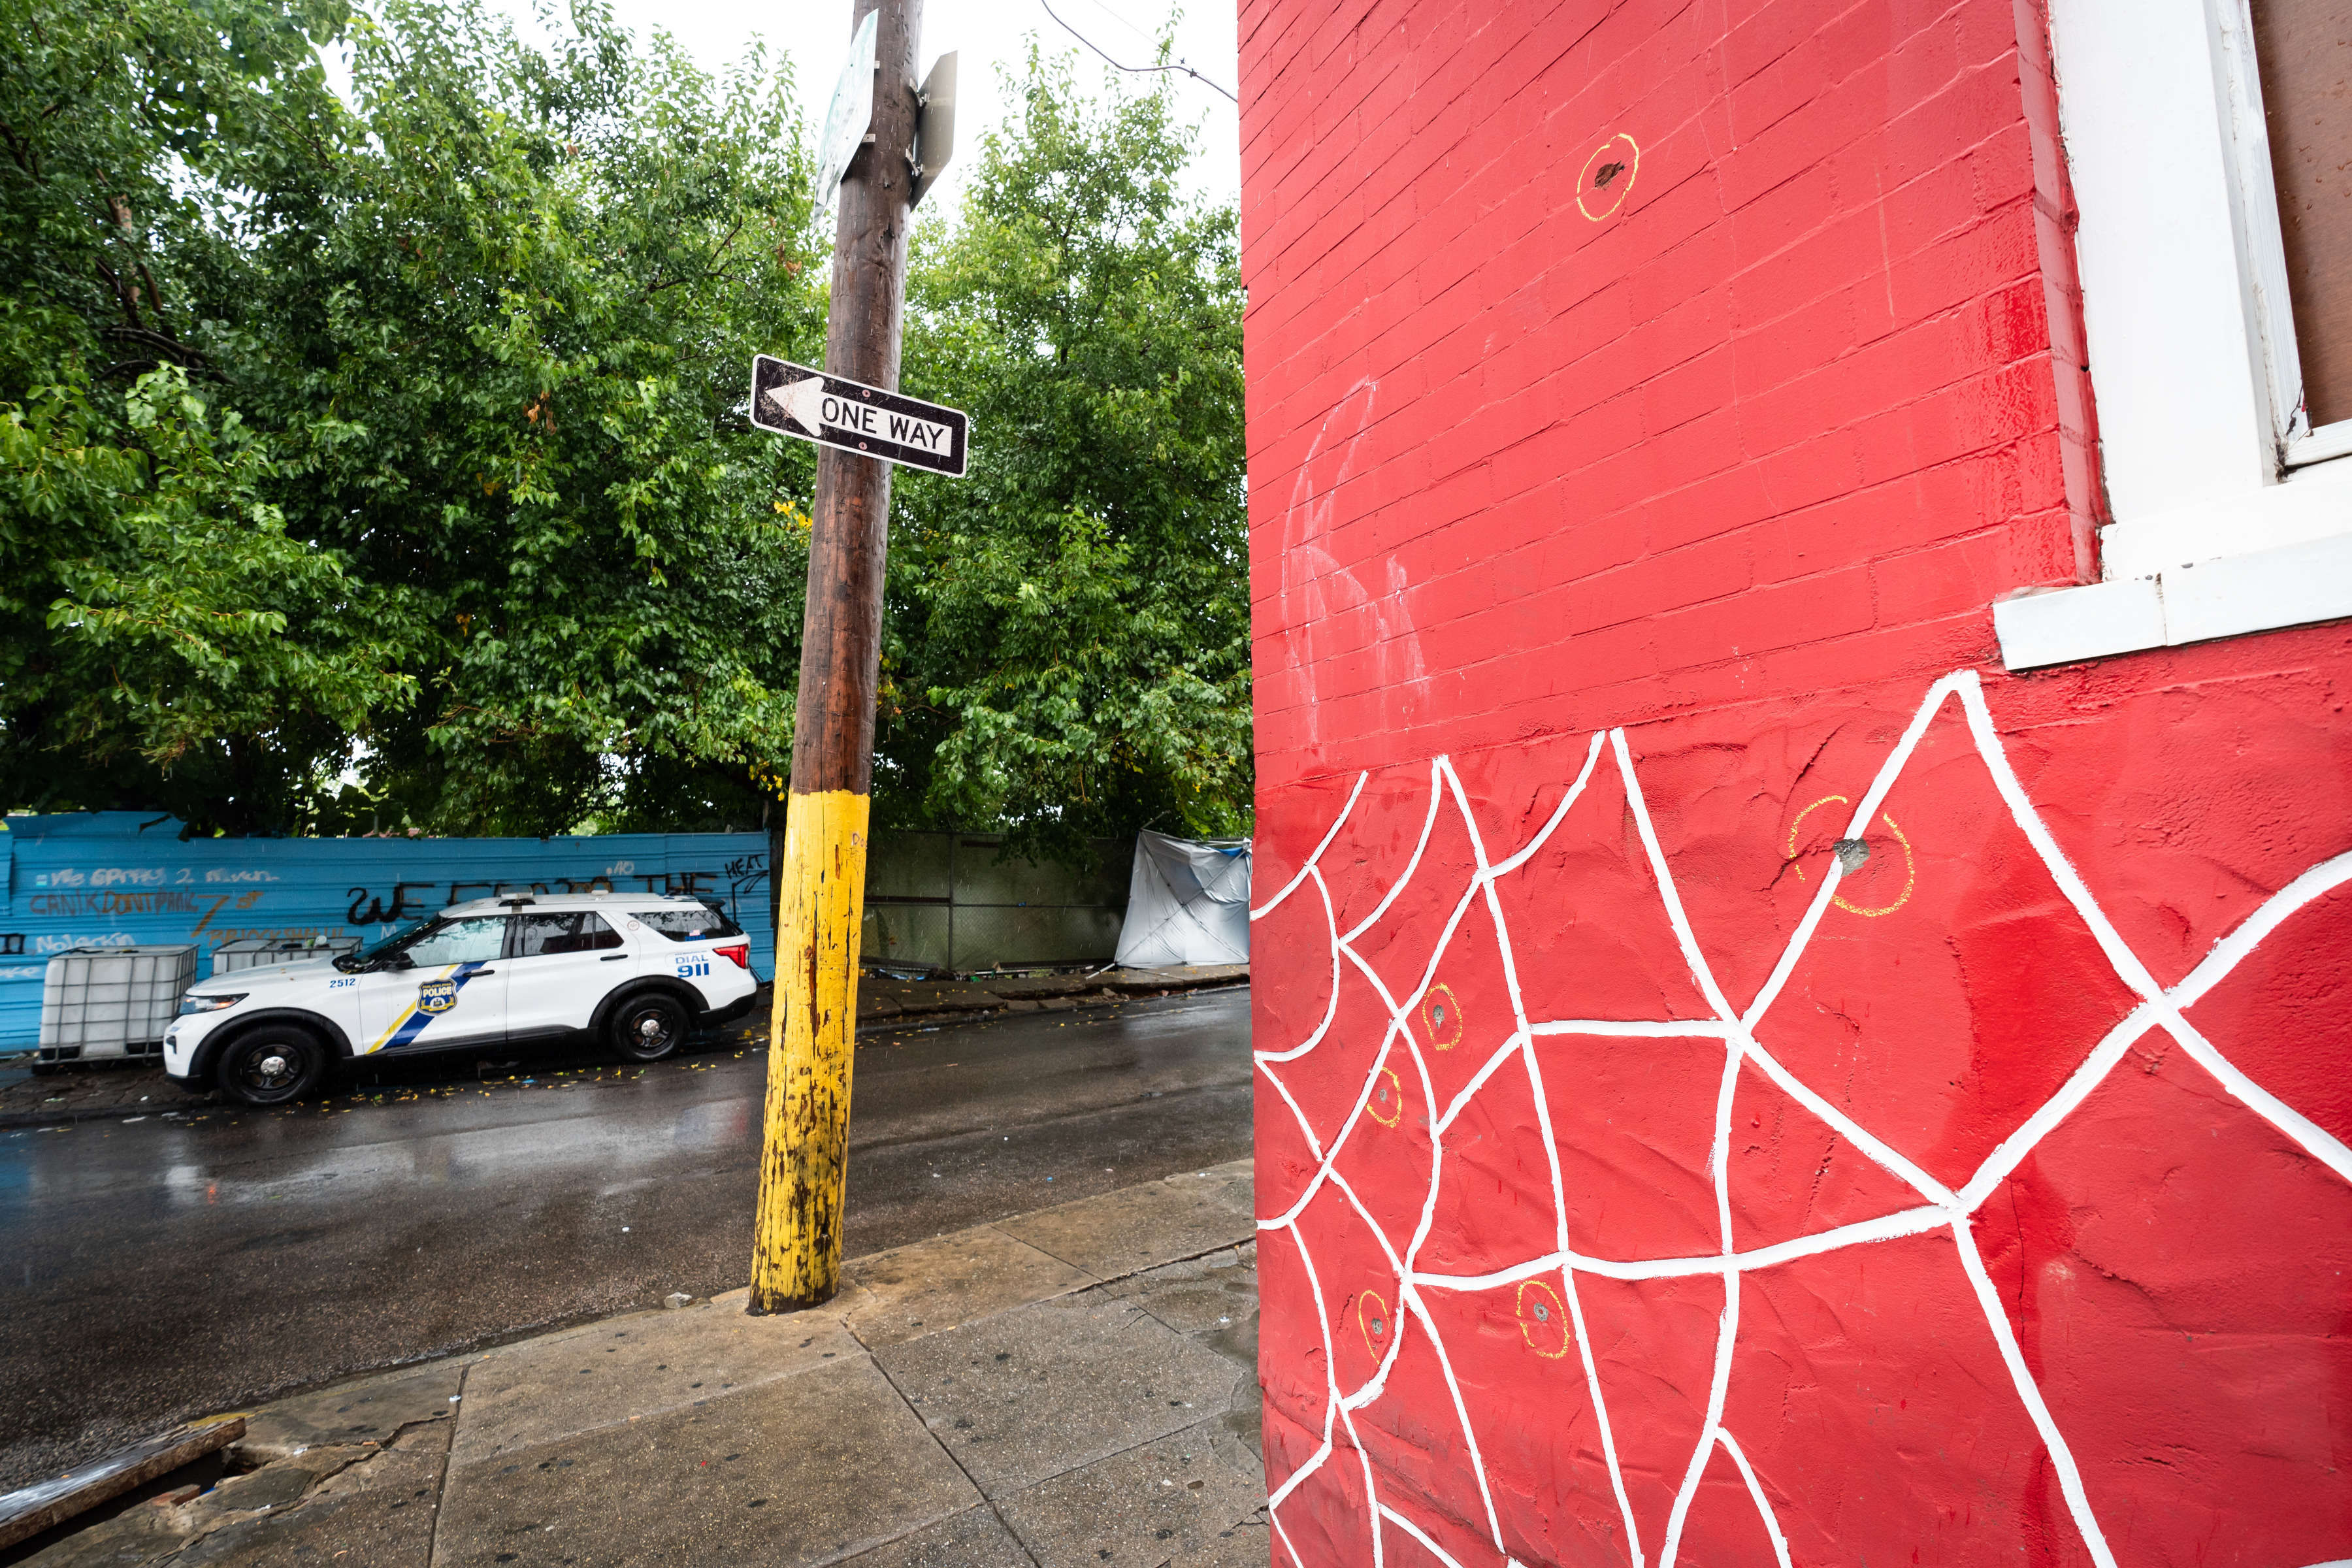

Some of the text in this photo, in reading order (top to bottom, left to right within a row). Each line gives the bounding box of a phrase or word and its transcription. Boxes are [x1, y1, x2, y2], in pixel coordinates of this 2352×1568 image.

[822, 398, 944, 449] ONE WAY
[725, 853, 765, 879] HEAT
[675, 955, 708, 964] DIAL
[678, 963, 710, 978] 911
[329, 978, 356, 988] 2512
[423, 986, 452, 998] POLICE
